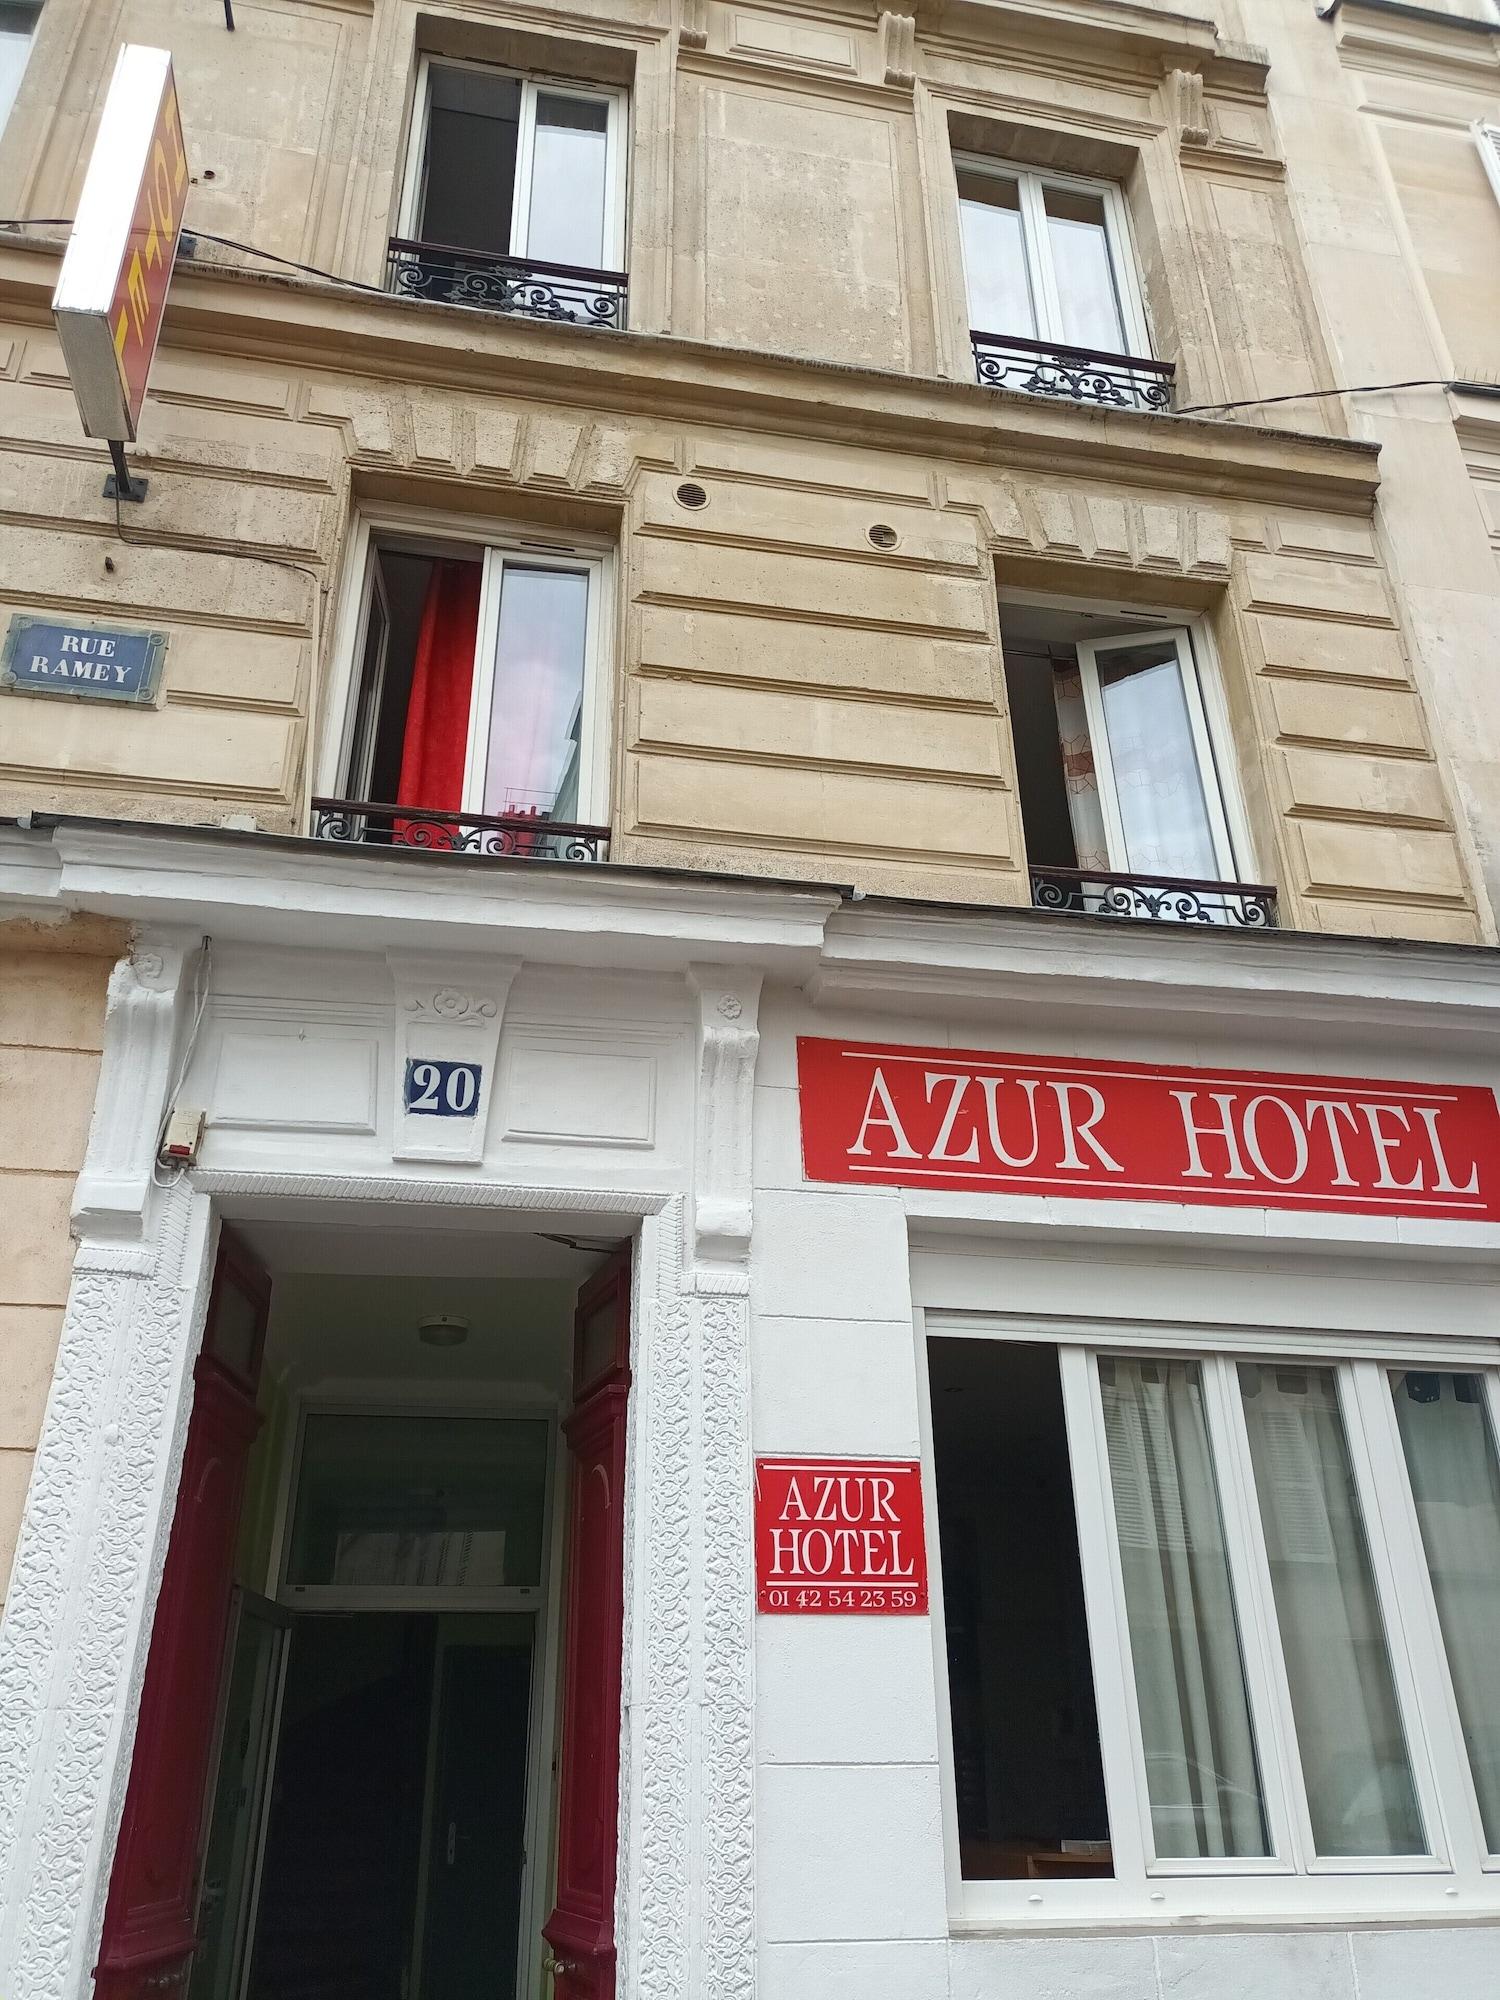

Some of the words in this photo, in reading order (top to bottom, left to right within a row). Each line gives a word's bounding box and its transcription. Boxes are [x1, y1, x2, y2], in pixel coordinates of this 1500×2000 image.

[114, 87, 187, 400] HOTEL
[29, 655, 131, 683] RAMEY
[60, 635, 117, 657] RUE
[408, 1064, 476, 1112] 20
[846, 1066, 1124, 1173] AZUR
[1168, 1090, 1480, 1195] HOTEL
[778, 1476, 901, 1522] AZUR
[769, 1528, 914, 1576] HOTEL
[769, 1590, 788, 1607] 01
[795, 1589, 822, 1608] 42
[828, 1590, 855, 1607] 54
[860, 1590, 886, 1608] 23
[891, 1590, 917, 1608] 59
